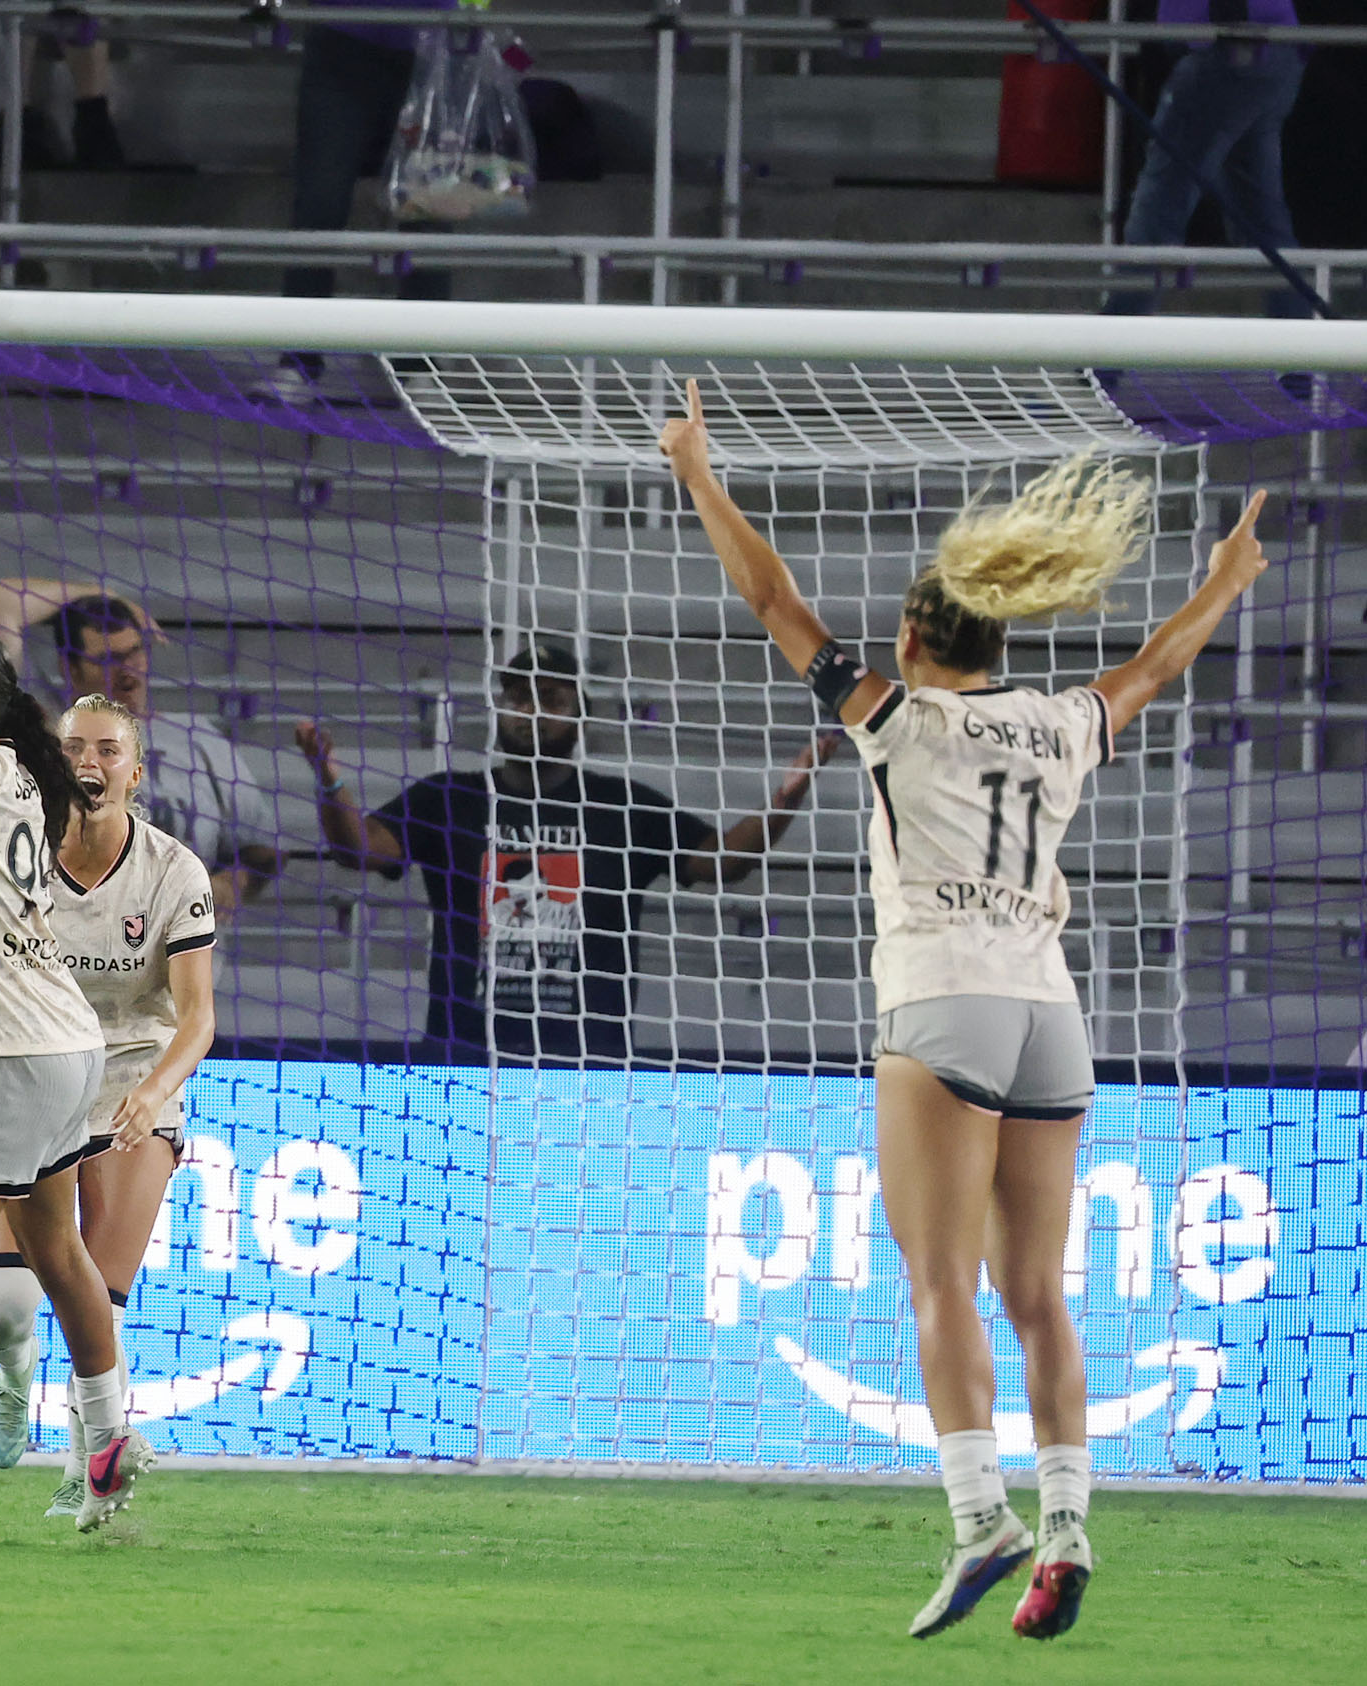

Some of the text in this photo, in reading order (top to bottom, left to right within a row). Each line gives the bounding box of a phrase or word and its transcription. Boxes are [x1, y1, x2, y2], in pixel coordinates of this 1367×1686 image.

[978, 768, 1044, 892] 11
[189, 891, 213, 919] all
[63, 954, 146, 973] ORDASH
